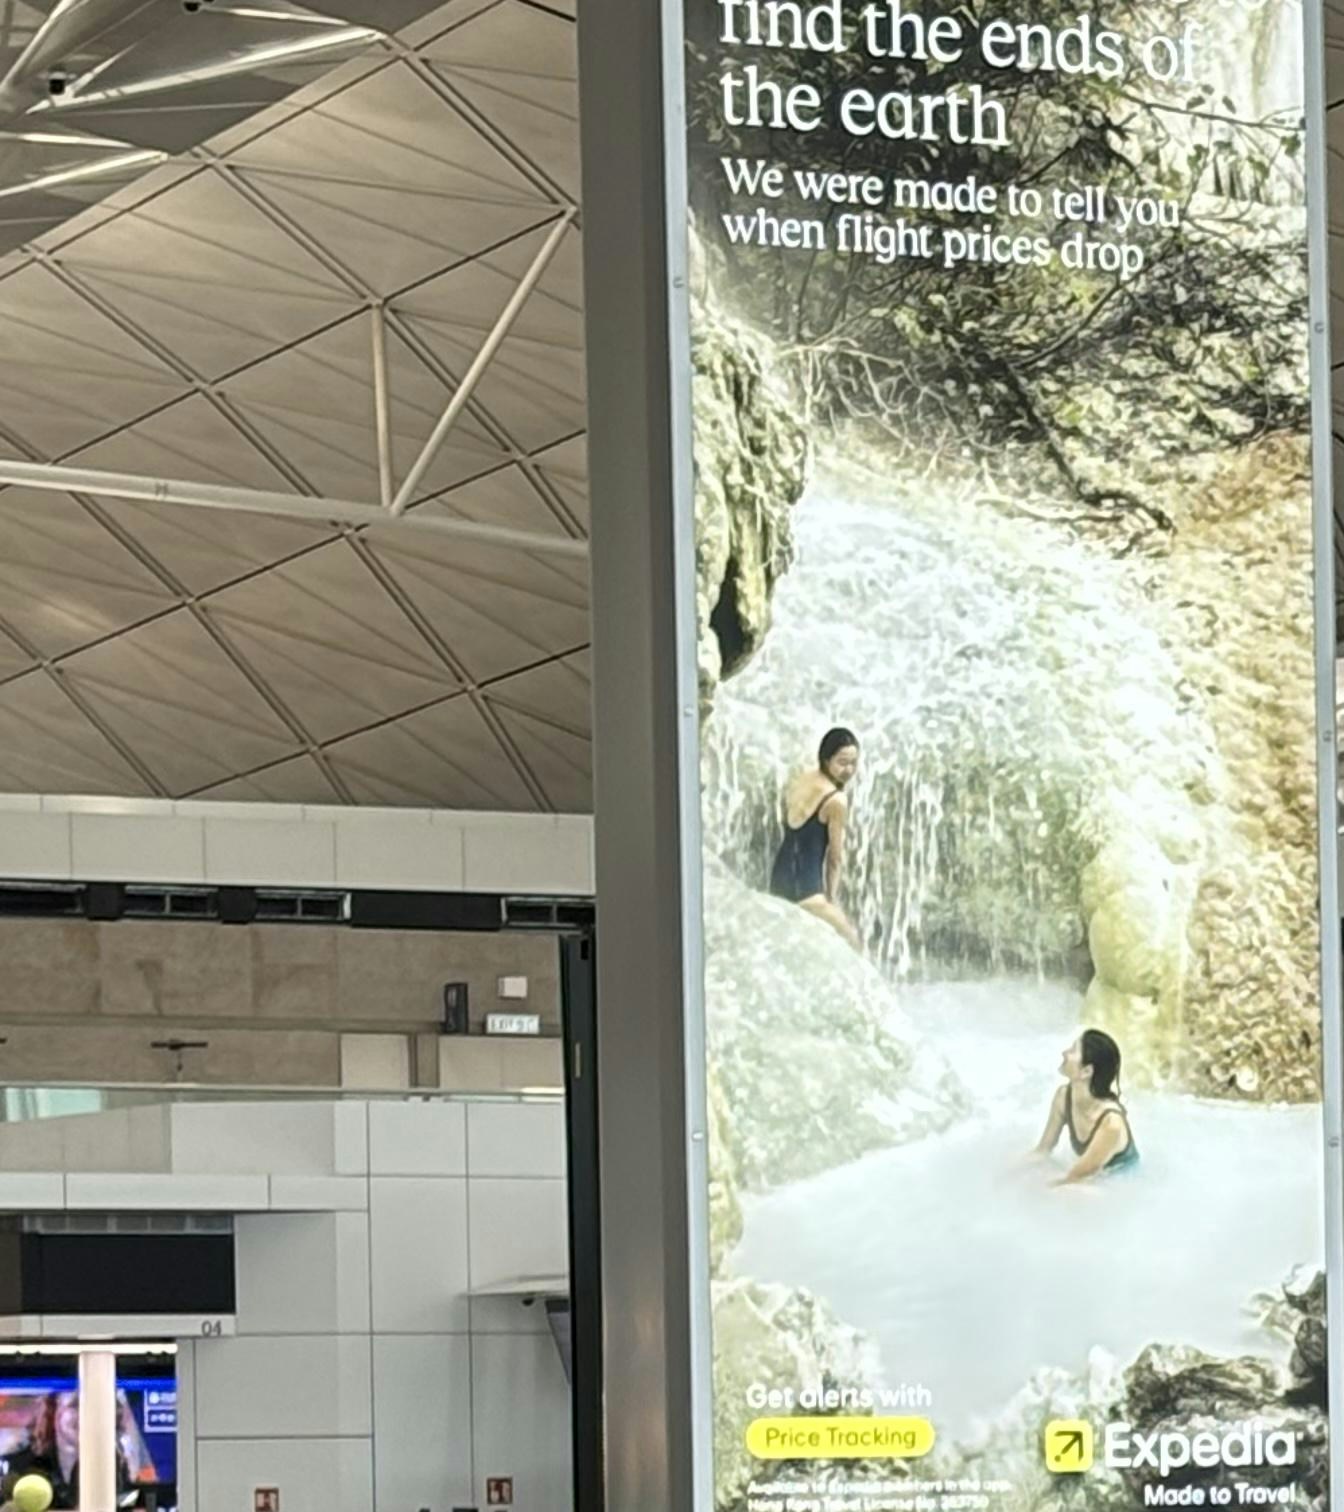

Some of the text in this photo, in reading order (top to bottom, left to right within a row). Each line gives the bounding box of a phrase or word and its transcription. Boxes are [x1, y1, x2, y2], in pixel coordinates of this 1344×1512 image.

[718, 0, 1204, 82] find the ends of
[719, 65, 1011, 147] the earth
[720, 157, 1180, 234] We were made to tell you
[721, 207, 1144, 281] when flight prices drop
[202, 1320, 222, 1337] 04
[746, 1382, 933, 1409] Get alerts with
[765, 1427, 917, 1449] Price Tracking
[1104, 1421, 1297, 1477] Expedia
[1144, 1482, 1296, 1507] Made to Travel
